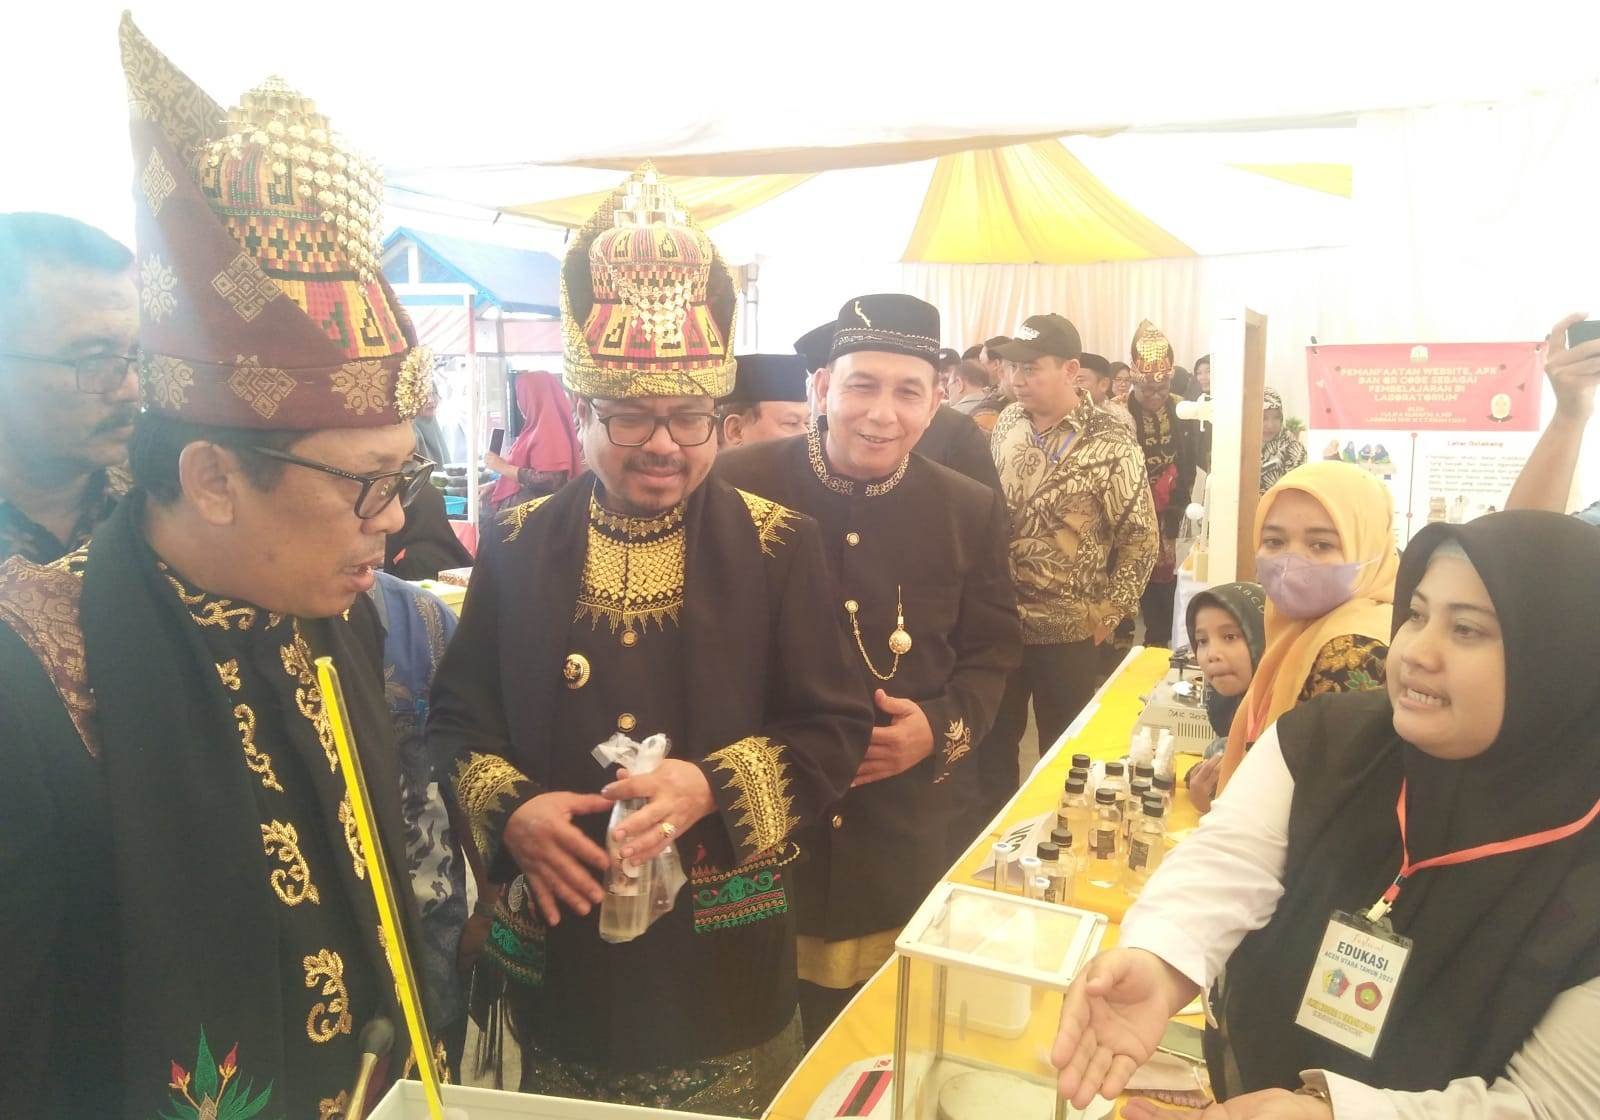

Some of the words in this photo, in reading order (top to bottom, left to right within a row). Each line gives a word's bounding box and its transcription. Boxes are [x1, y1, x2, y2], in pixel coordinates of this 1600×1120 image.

[1340, 367, 1420, 377] PEMANFAATAN
[1400, 376, 1428, 385] CODE
[1431, 376, 1478, 384] SEBAGAI
[1368, 384, 1453, 393] PEMBELAJARAN
[1374, 393, 1458, 401] LABORATORIUM
[1337, 941, 1389, 971] EDUKASI
[1341, 957, 1359, 970] UTARA
[1359, 963, 1378, 978] TAHUN
